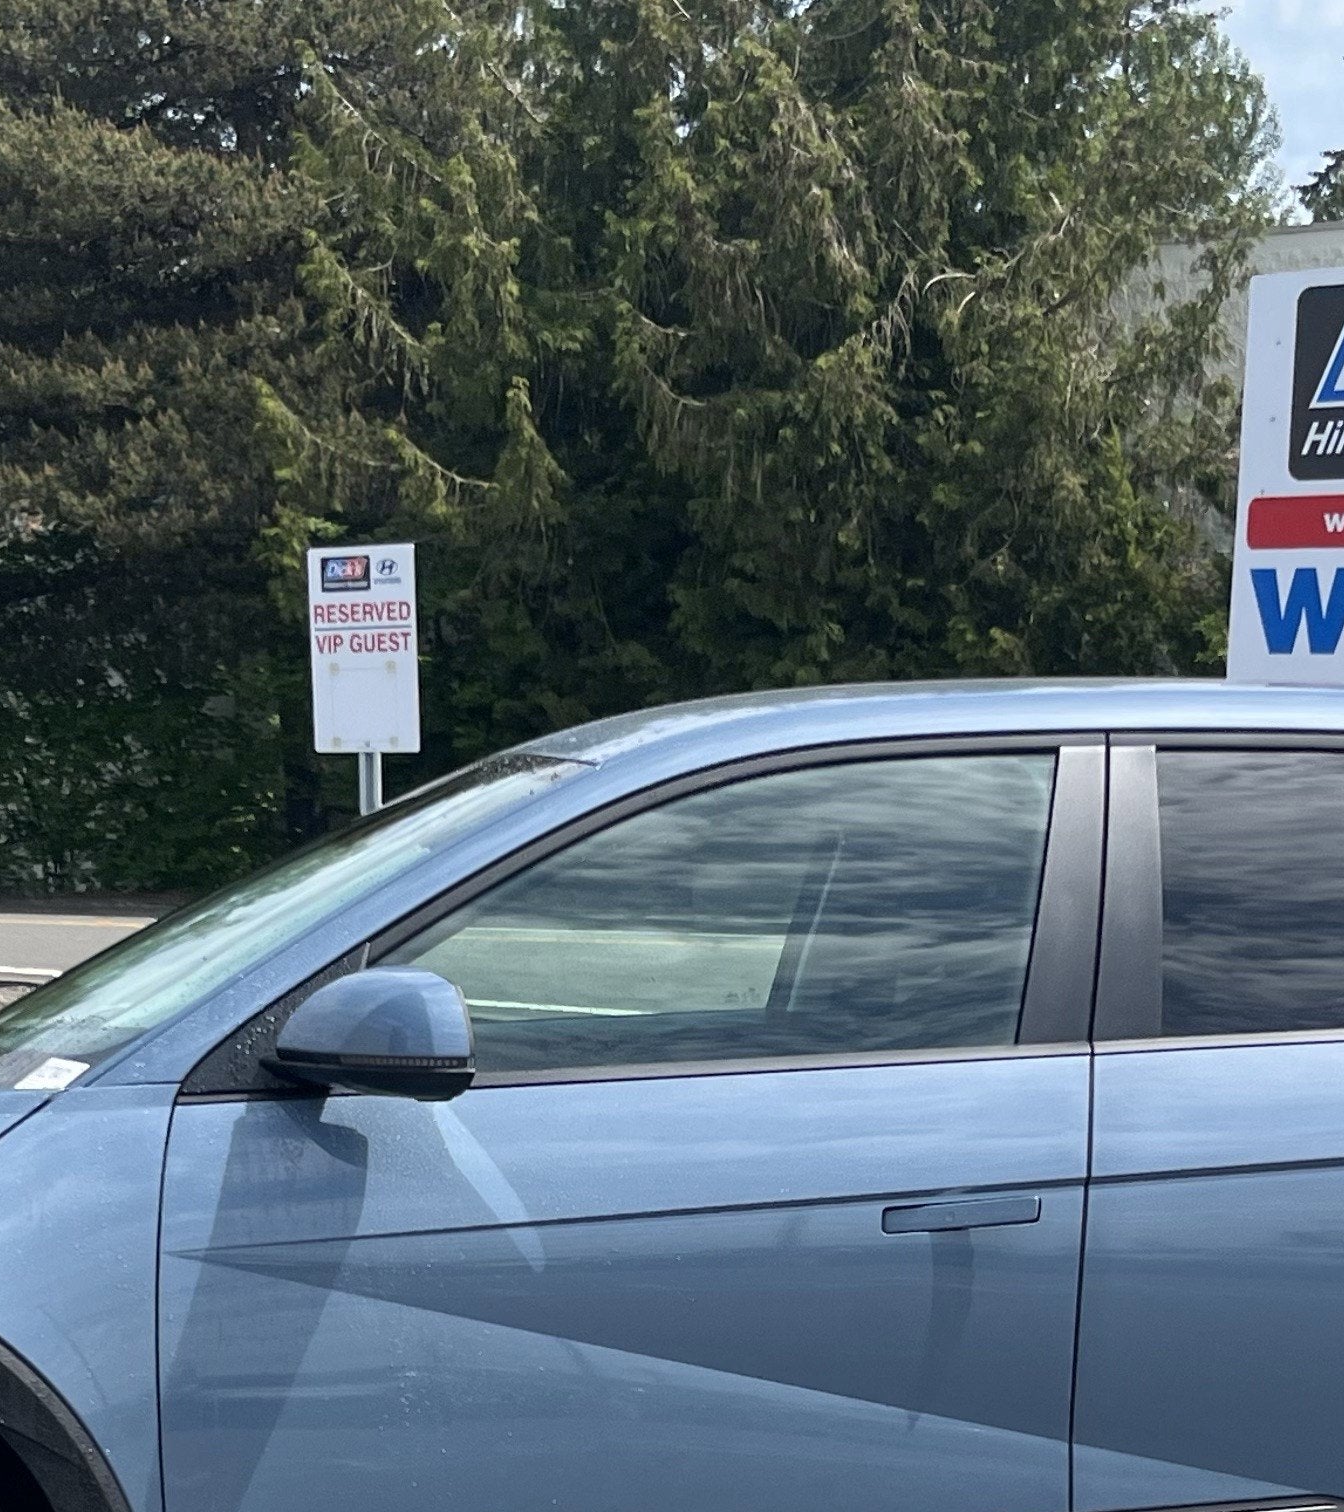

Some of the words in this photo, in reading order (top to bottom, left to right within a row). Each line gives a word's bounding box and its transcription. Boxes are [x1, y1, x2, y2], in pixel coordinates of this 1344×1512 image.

[313, 601, 411, 624] RESERVED
[315, 634, 344, 655] VIP
[349, 631, 411, 654] GUEST
